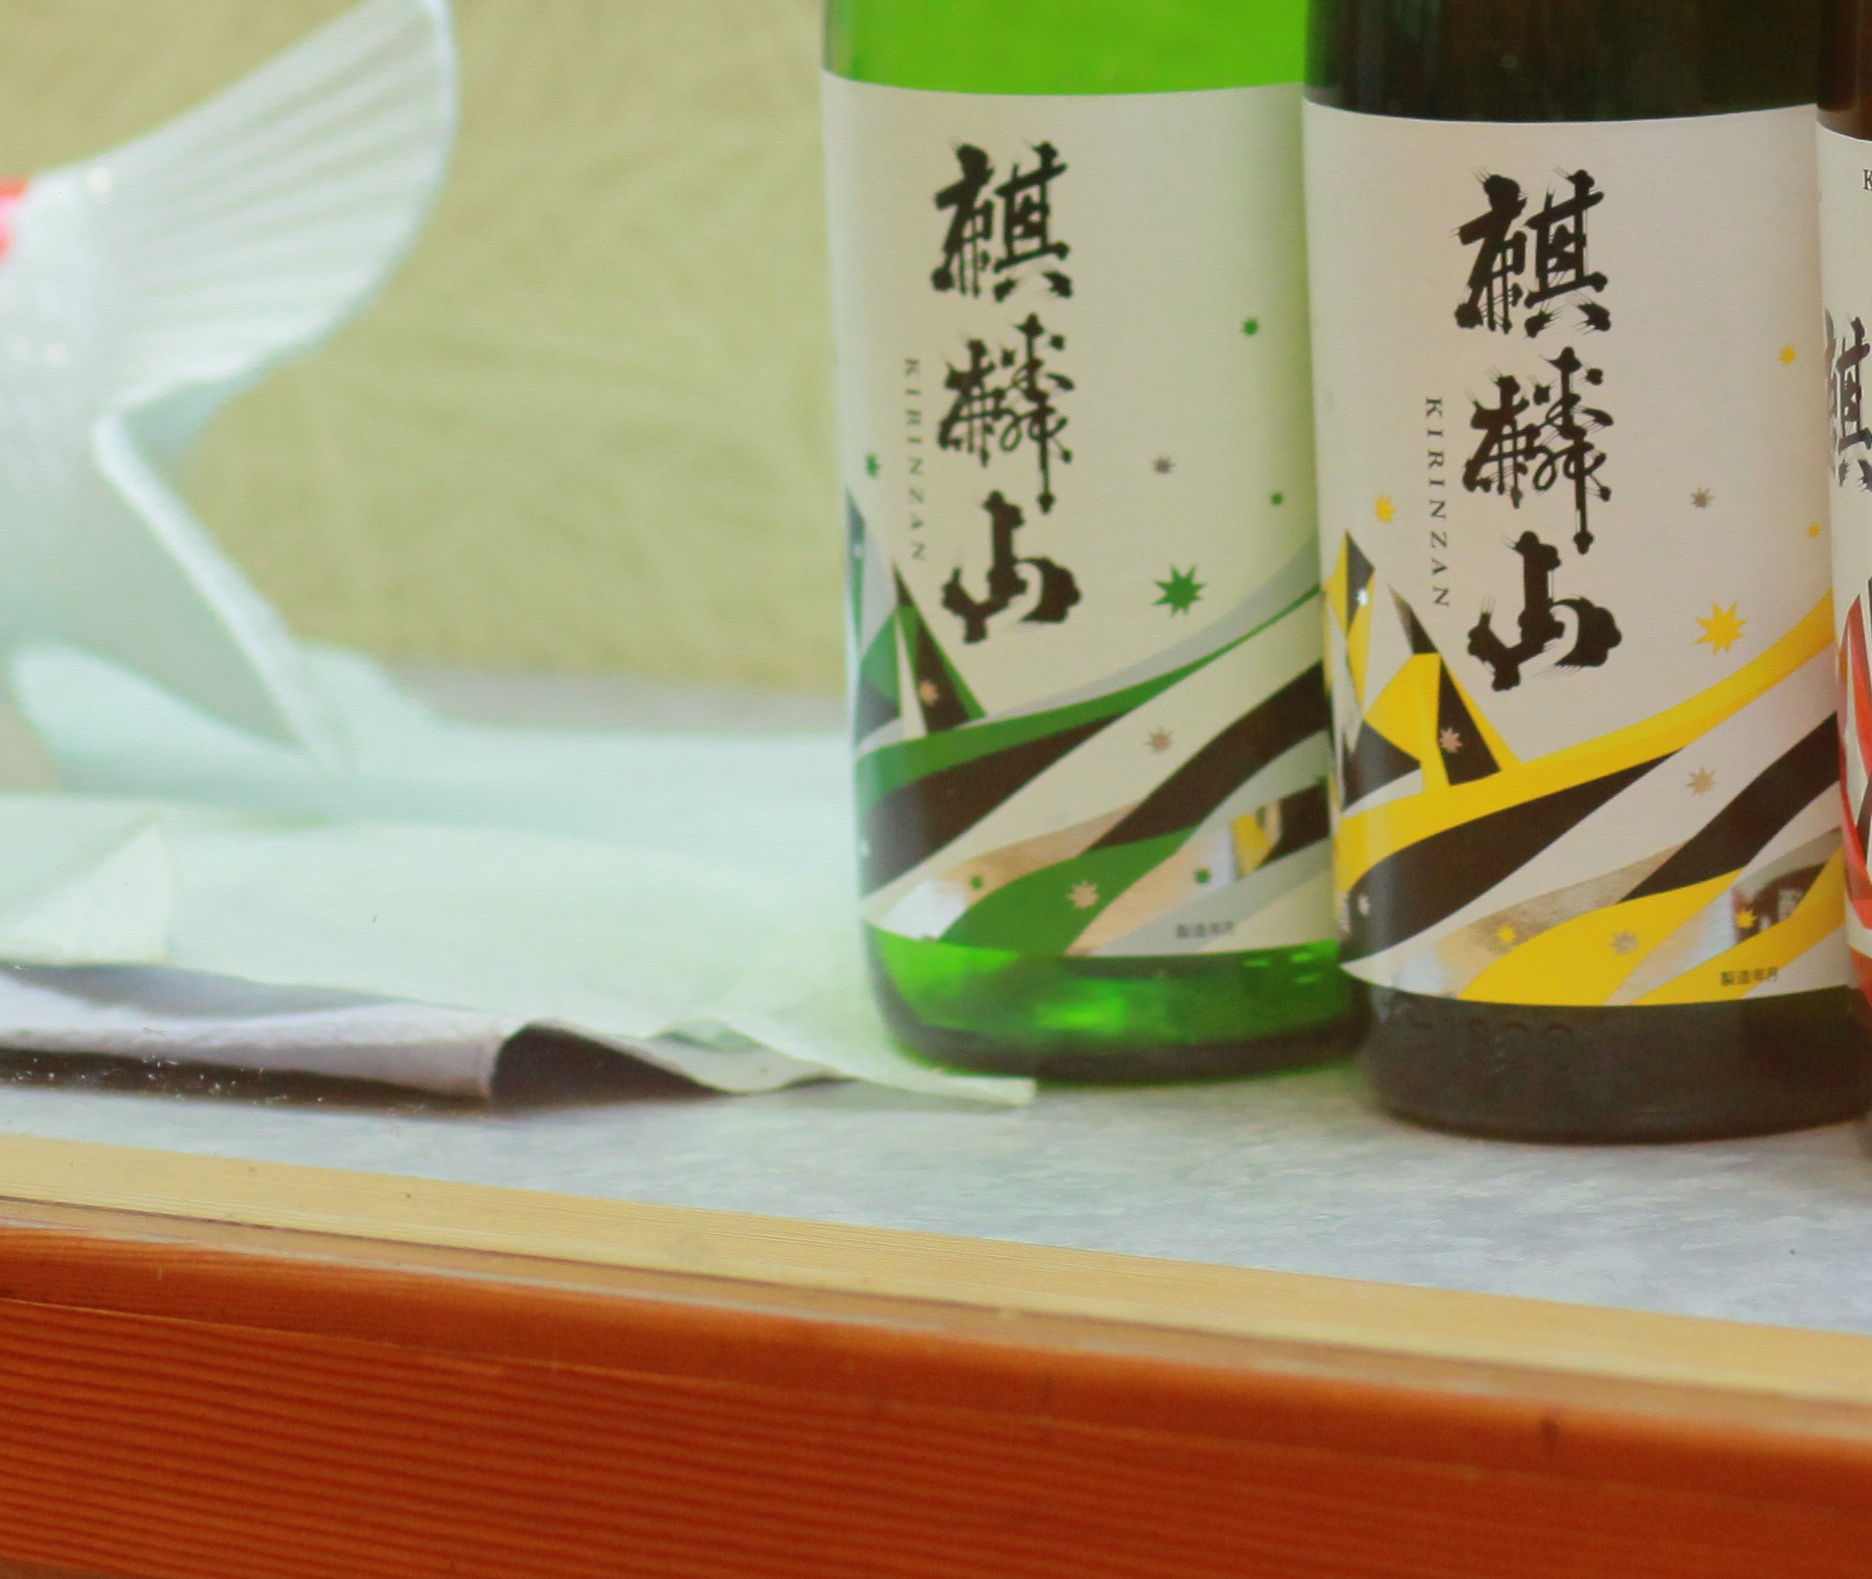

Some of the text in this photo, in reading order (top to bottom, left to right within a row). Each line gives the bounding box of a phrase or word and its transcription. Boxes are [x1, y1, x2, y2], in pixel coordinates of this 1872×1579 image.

[905, 358, 926, 560] KIRINZAN
[932, 142, 1080, 644] 麒麟山
[1426, 397, 1450, 607] KIRINZAN
[1453, 168, 1622, 692] 麒麟山
